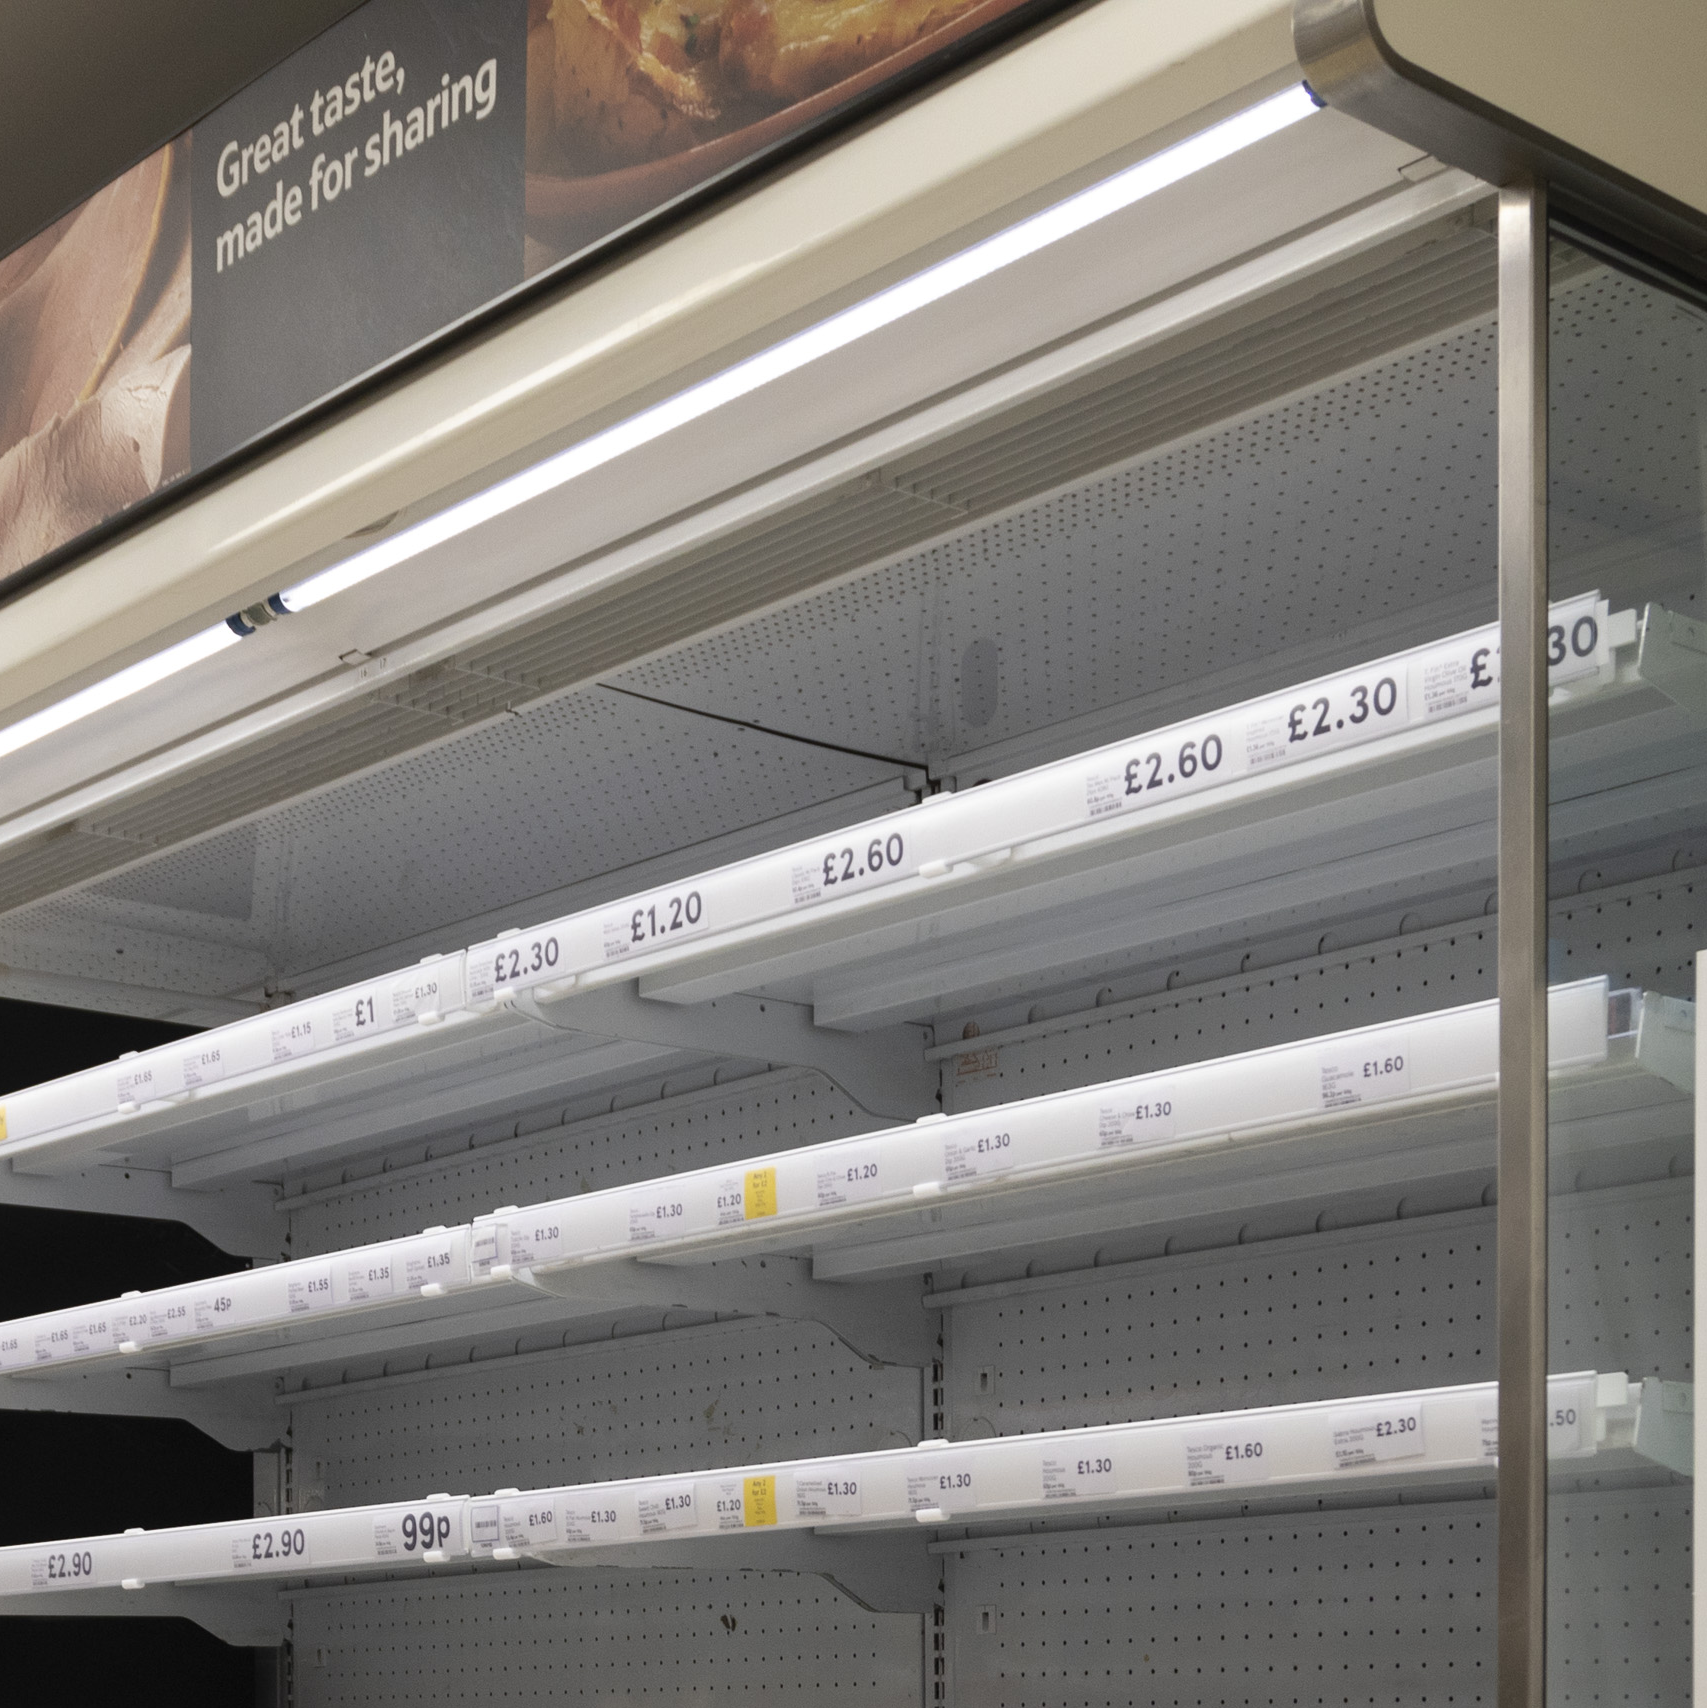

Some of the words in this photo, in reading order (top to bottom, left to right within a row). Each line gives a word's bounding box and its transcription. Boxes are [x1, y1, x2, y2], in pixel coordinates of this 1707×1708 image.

[215, 105, 304, 199] Great
[309, 48, 406, 133] taste,
[215, 191, 304, 273] made
[308, 147, 356, 212] for
[362, 56, 498, 180] sharing
[1470, 615, 1600, 690] £30
[1287, 677, 1398, 744] £2.30
[1123, 733, 1224, 797] £2.60
[823, 831, 905, 887] £2.60
[630, 891, 703, 944] £1.20
[494, 935, 560, 983] £2.30
[414, 980, 439, 1001] £1.30
[354, 996, 376, 1029] £1
[291, 1021, 313, 1039] £1.15
[200, 1049, 221, 1068] £1.65
[1363, 1055, 1405, 1078] £1.60
[133, 1068, 153, 1090] £1.65
[1135, 1102, 1172, 1120] £1.30
[977, 1133, 1010, 1154] £1.30
[847, 1164, 878, 1183] £1.20
[717, 1194, 742, 1208] £1.20
[656, 1203, 683, 1219] £1.30
[535, 1226, 559, 1242] £1.30
[427, 1252, 451, 1269] £1.35
[368, 1267, 390, 1282] £1.35
[308, 1278, 329, 1294] £1.55
[167, 1306, 186, 1319] £2.55
[214, 1297, 232, 1313] 45p
[88, 1322, 107, 1335] £1.65
[129, 1314, 147, 1326] £2.20
[1, 1339, 18, 1352] £1.65
[51, 1329, 69, 1343] £1.65
[1376, 1416, 1417, 1438] £2.30
[1225, 1442, 1264, 1462] £1.60
[1077, 1458, 1113, 1476] £1.30
[827, 1481, 858, 1497] £1.30
[939, 1472, 972, 1492] £1.30
[665, 1494, 692, 1512] £1.30
[716, 1499, 742, 1515] £1.20
[528, 1510, 554, 1528] £1.60
[591, 1509, 617, 1525] £1.30
[401, 1511, 451, 1552] 99p
[252, 1528, 306, 1561] £2.90
[48, 1551, 93, 1580] £2.90
